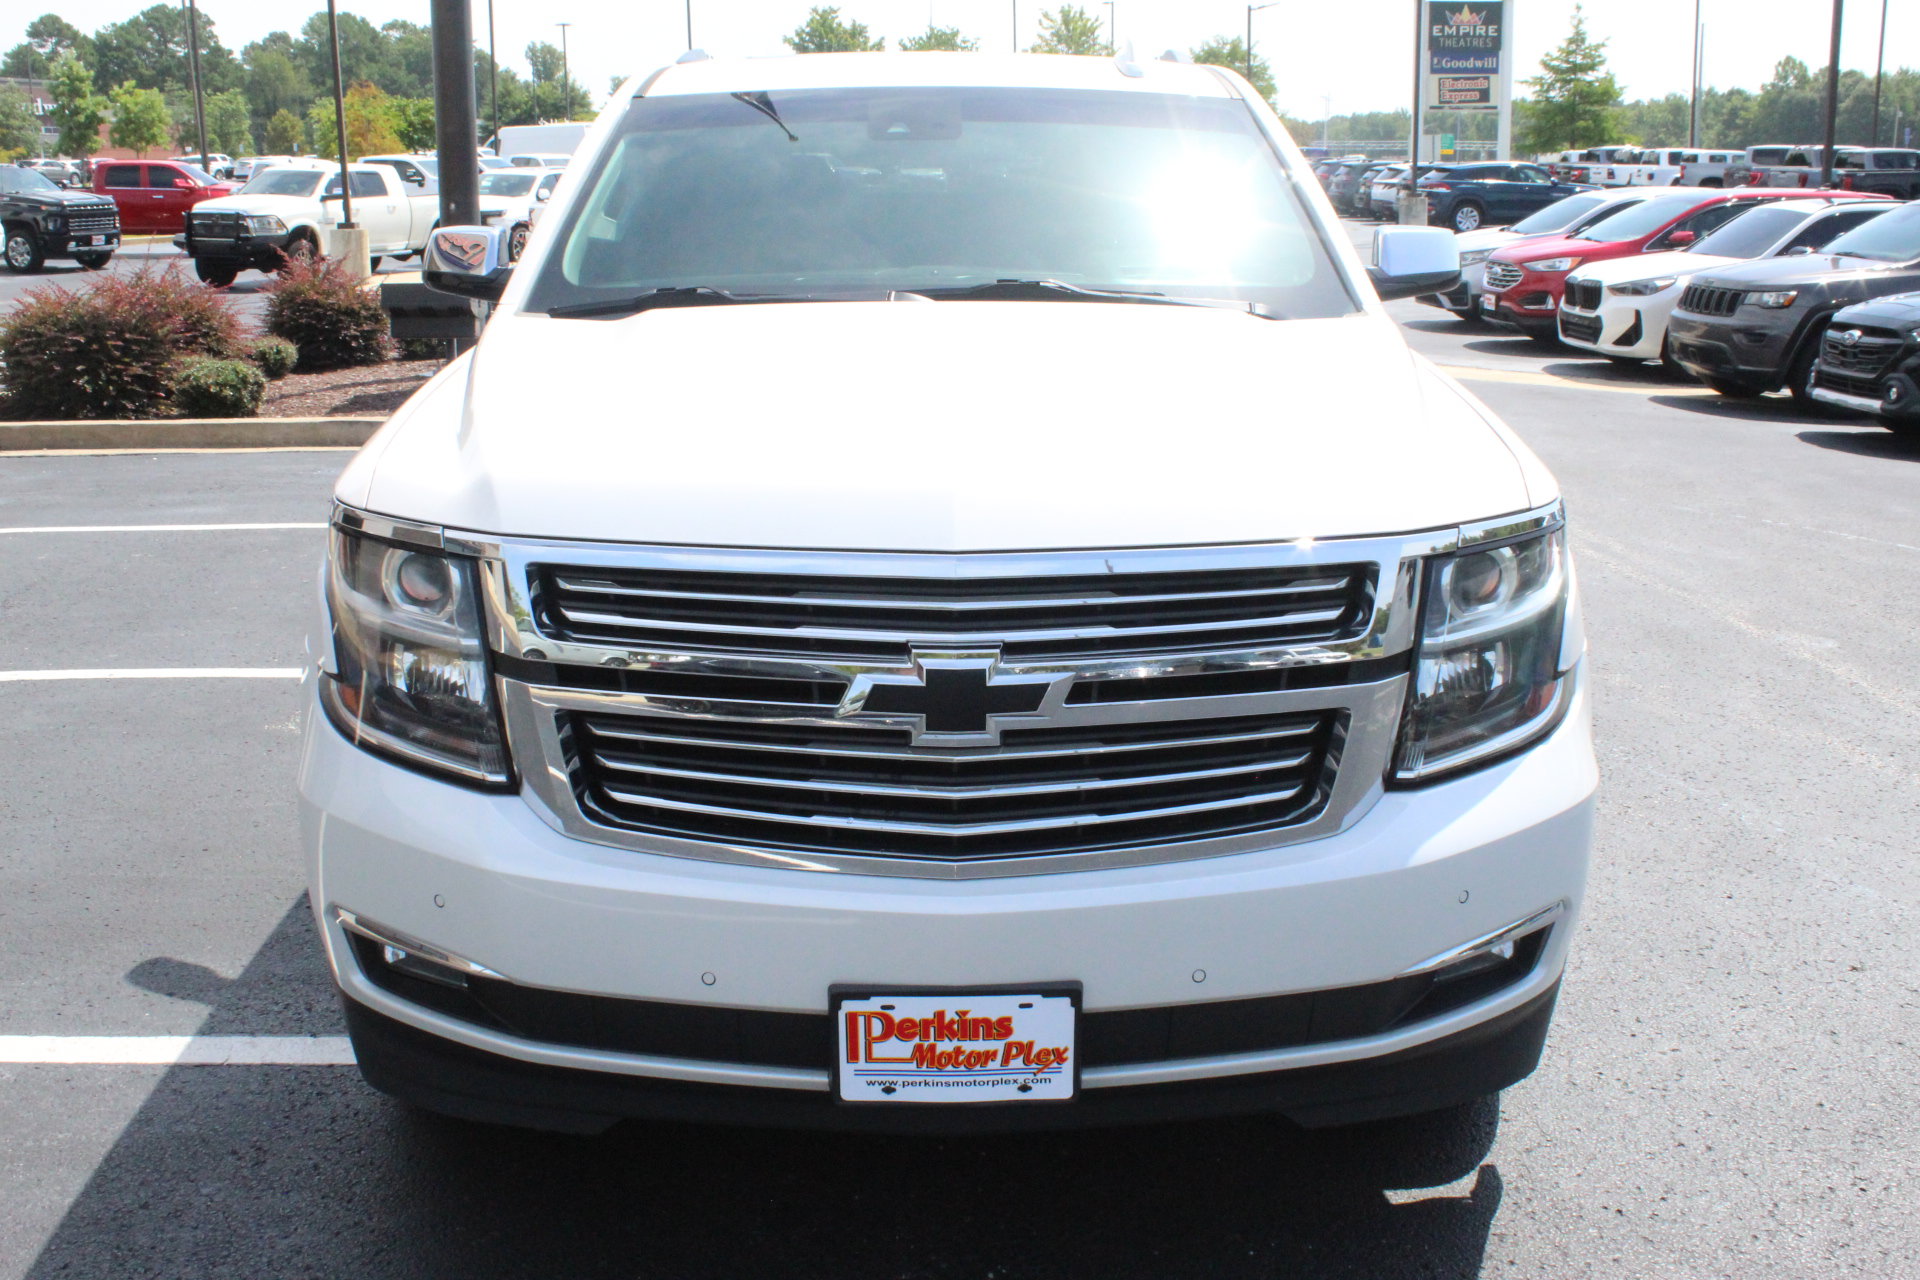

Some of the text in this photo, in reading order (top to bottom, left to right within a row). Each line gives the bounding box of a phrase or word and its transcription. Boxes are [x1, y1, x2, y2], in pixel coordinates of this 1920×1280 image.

[1432, 25, 1498, 36] EMPIRE
[1439, 37, 1493, 48] THEATRES
[1442, 57, 1497, 69] Goodwill
[1441, 78, 1488, 89] Electronic
[1441, 90, 1480, 103] Express
[845, 1010, 1014, 1063] Perkins
[912, 1040, 1070, 1076] Motor Plex
[866, 1076, 1052, 1088] www.perkinsmotorplex.com
